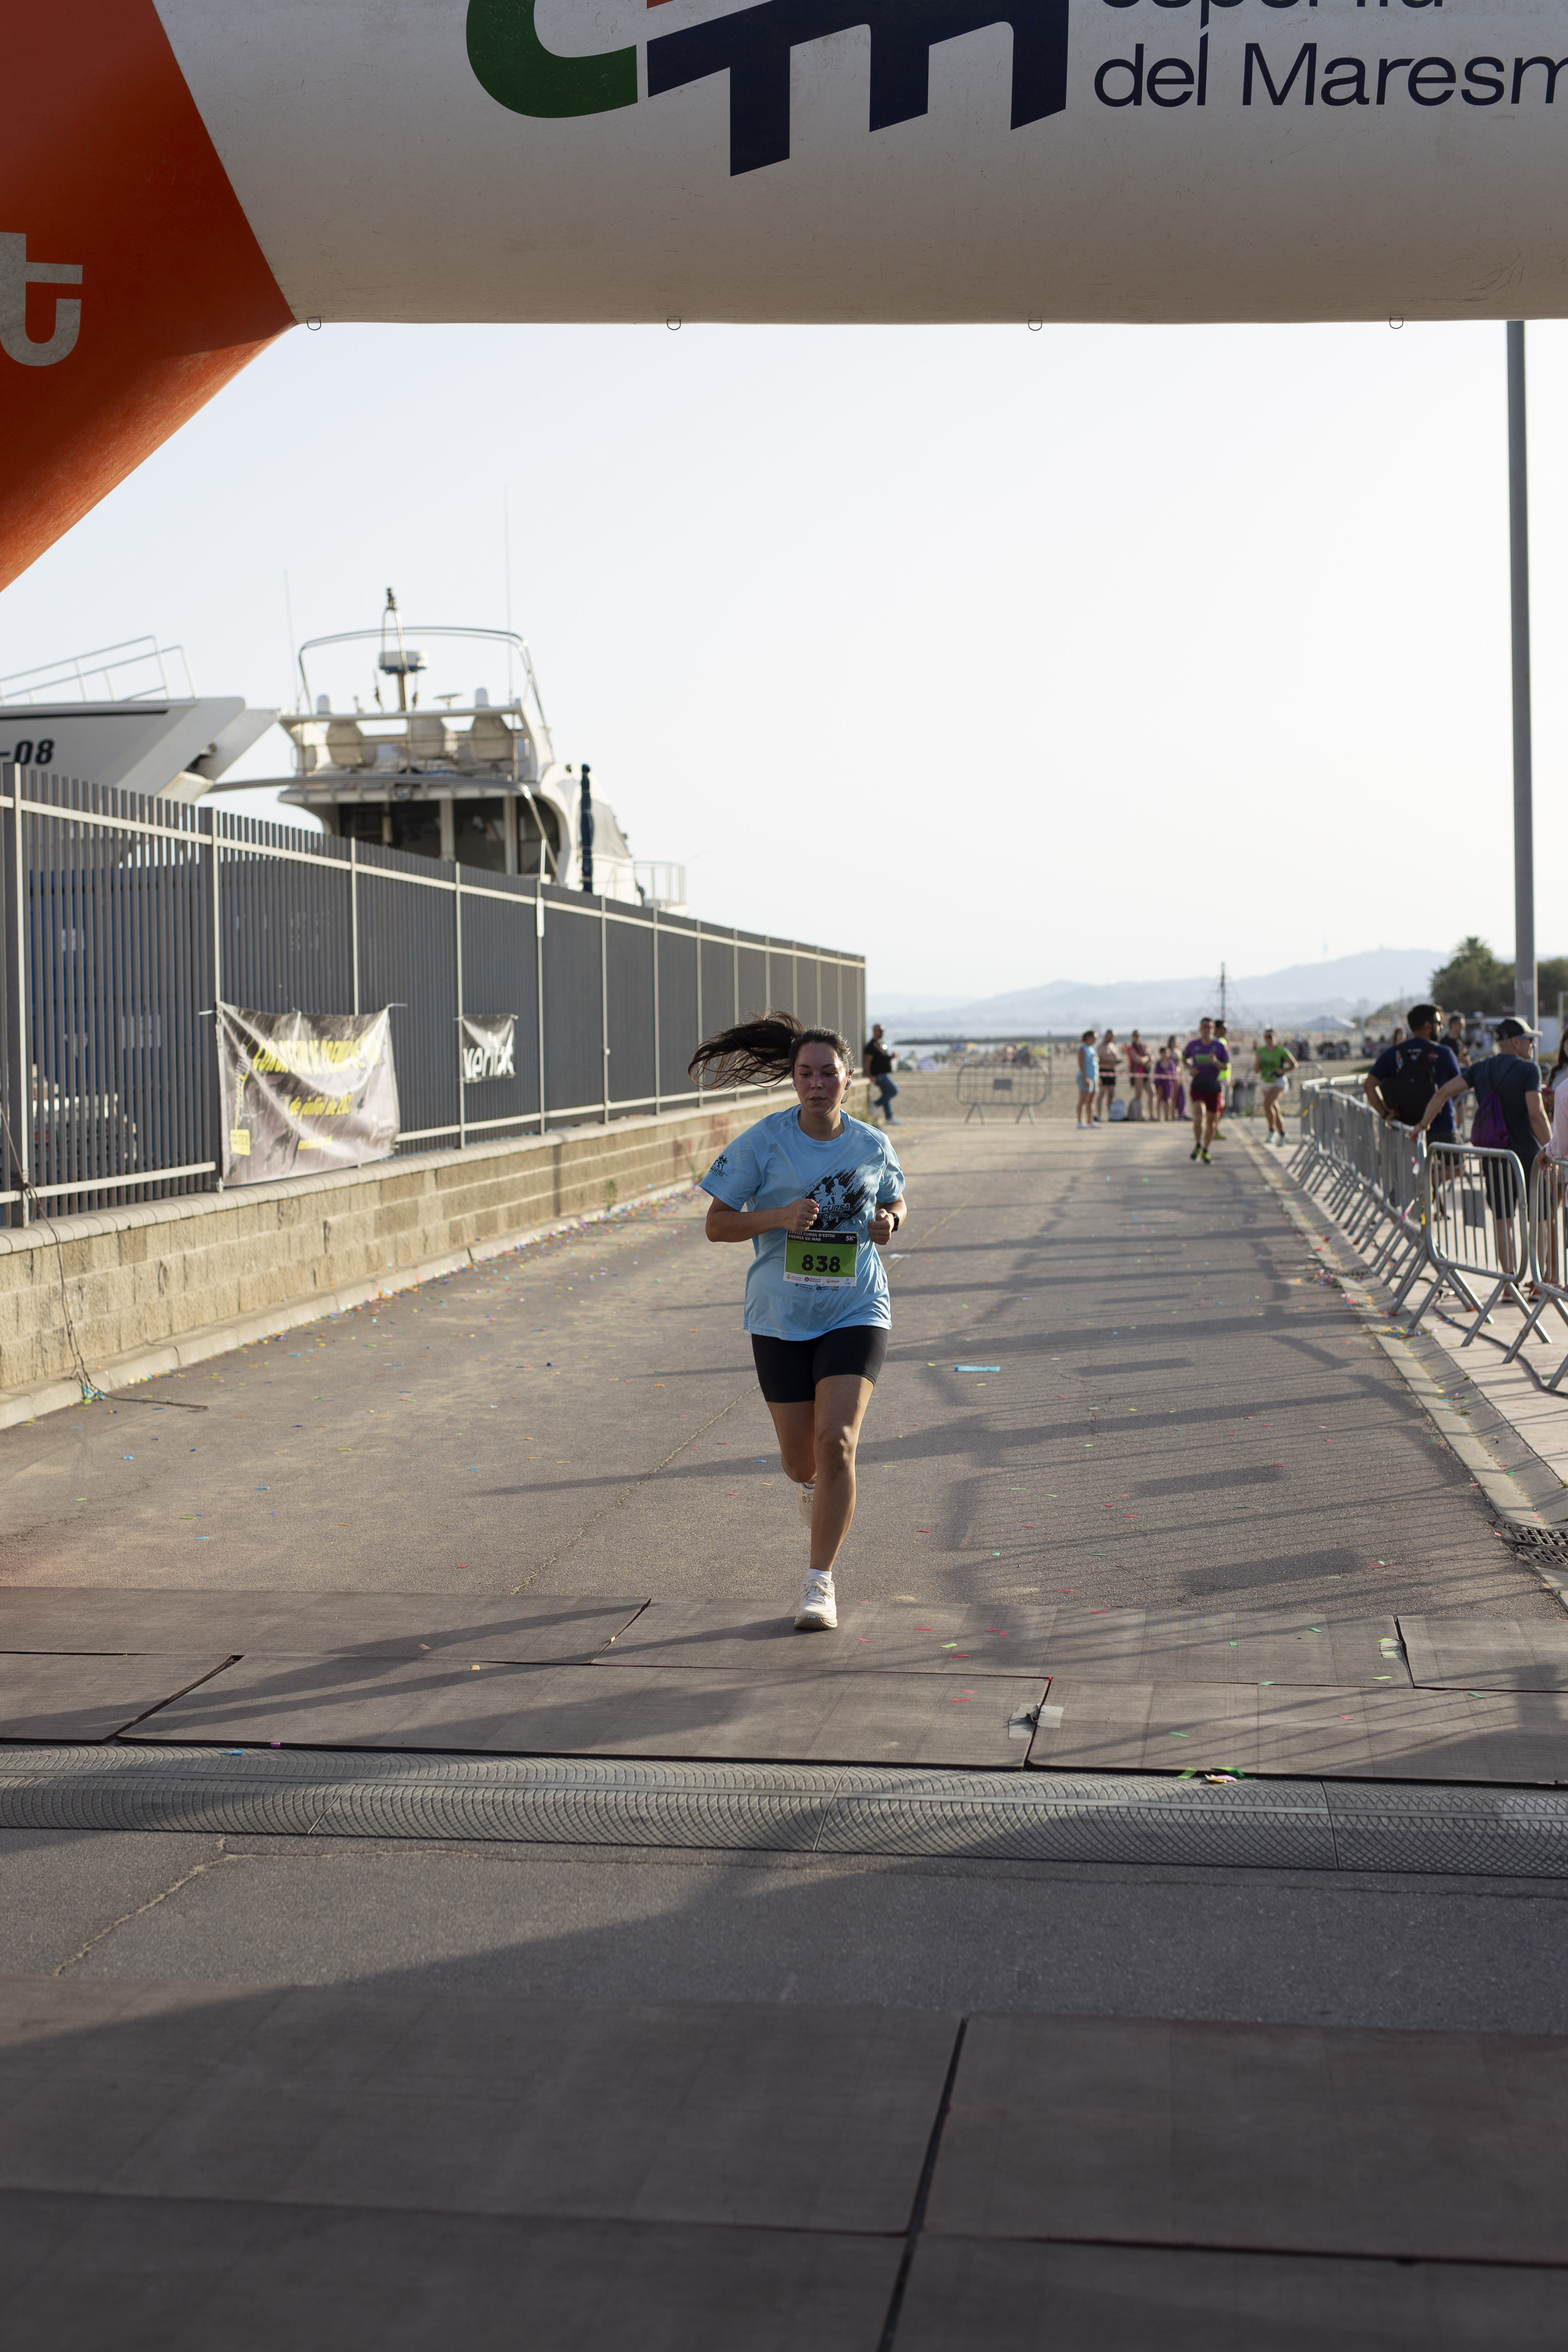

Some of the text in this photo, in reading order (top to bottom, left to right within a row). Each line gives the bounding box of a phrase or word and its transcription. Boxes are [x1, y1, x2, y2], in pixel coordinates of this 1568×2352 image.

[1094, 32, 1568, 107] del Maresm
[821, 1204, 849, 1213] CURSA
[801, 1254, 841, 1273] 838
